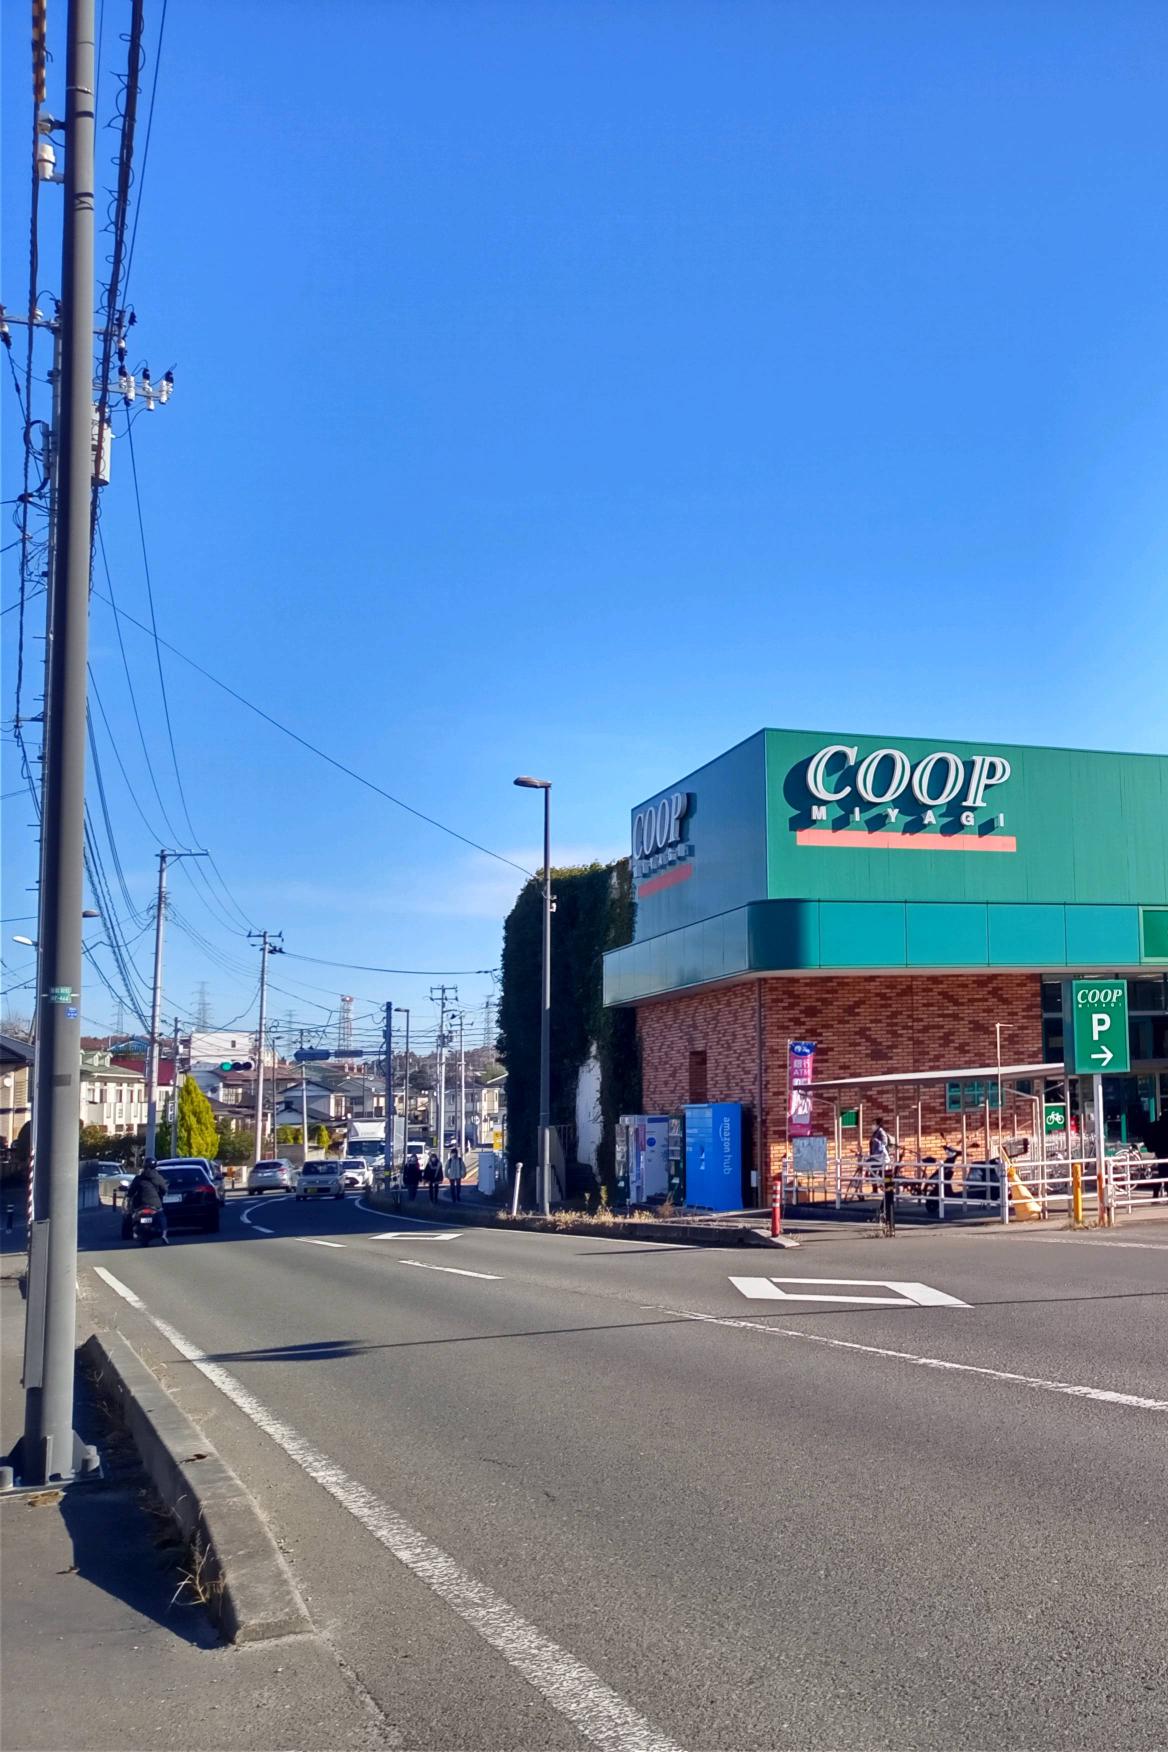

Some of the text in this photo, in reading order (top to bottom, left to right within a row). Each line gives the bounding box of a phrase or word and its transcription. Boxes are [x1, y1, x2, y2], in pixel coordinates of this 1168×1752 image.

[806, 744, 1012, 808] COOP
[633, 792, 688, 860] COOP
[810, 804, 1005, 828] MIYAGI
[1077, 989, 1123, 1004] COOP
[1091, 1013, 1111, 1041] P
[723, 1116, 733, 1175] amazon hub
